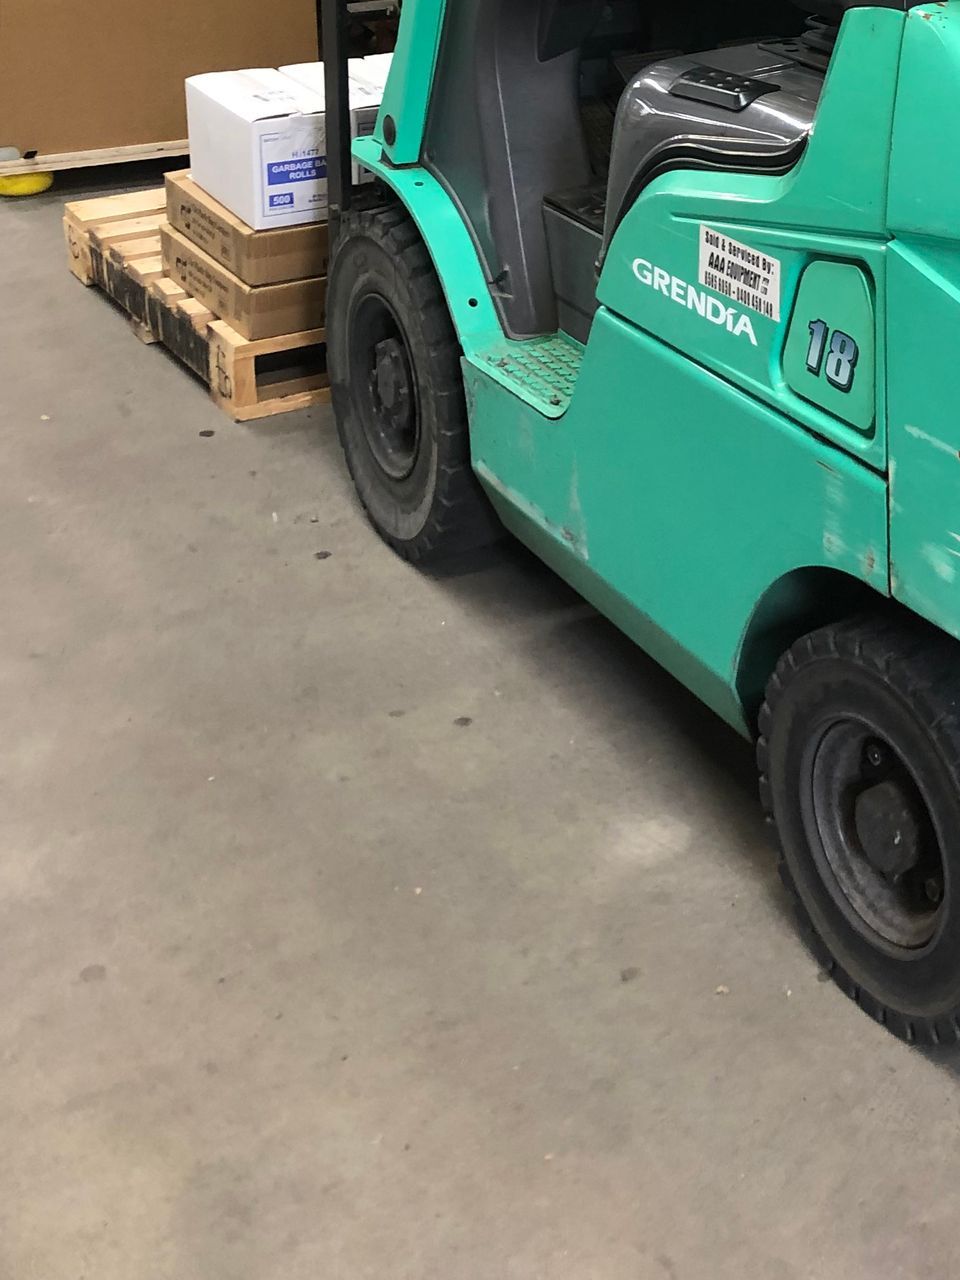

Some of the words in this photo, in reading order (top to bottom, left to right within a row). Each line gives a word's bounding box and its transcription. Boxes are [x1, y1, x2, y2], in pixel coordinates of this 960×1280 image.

[272, 161, 313, 173] GARBAGE
[289, 169, 316, 180] ROLLS
[273, 195, 290, 205] 500
[728, 242, 760, 268] Serviced
[708, 252, 725, 273] AAA
[726, 260, 761, 291] EQUIPMENT
[632, 258, 758, 346] GRENDIA
[806, 318, 859, 394] 18
